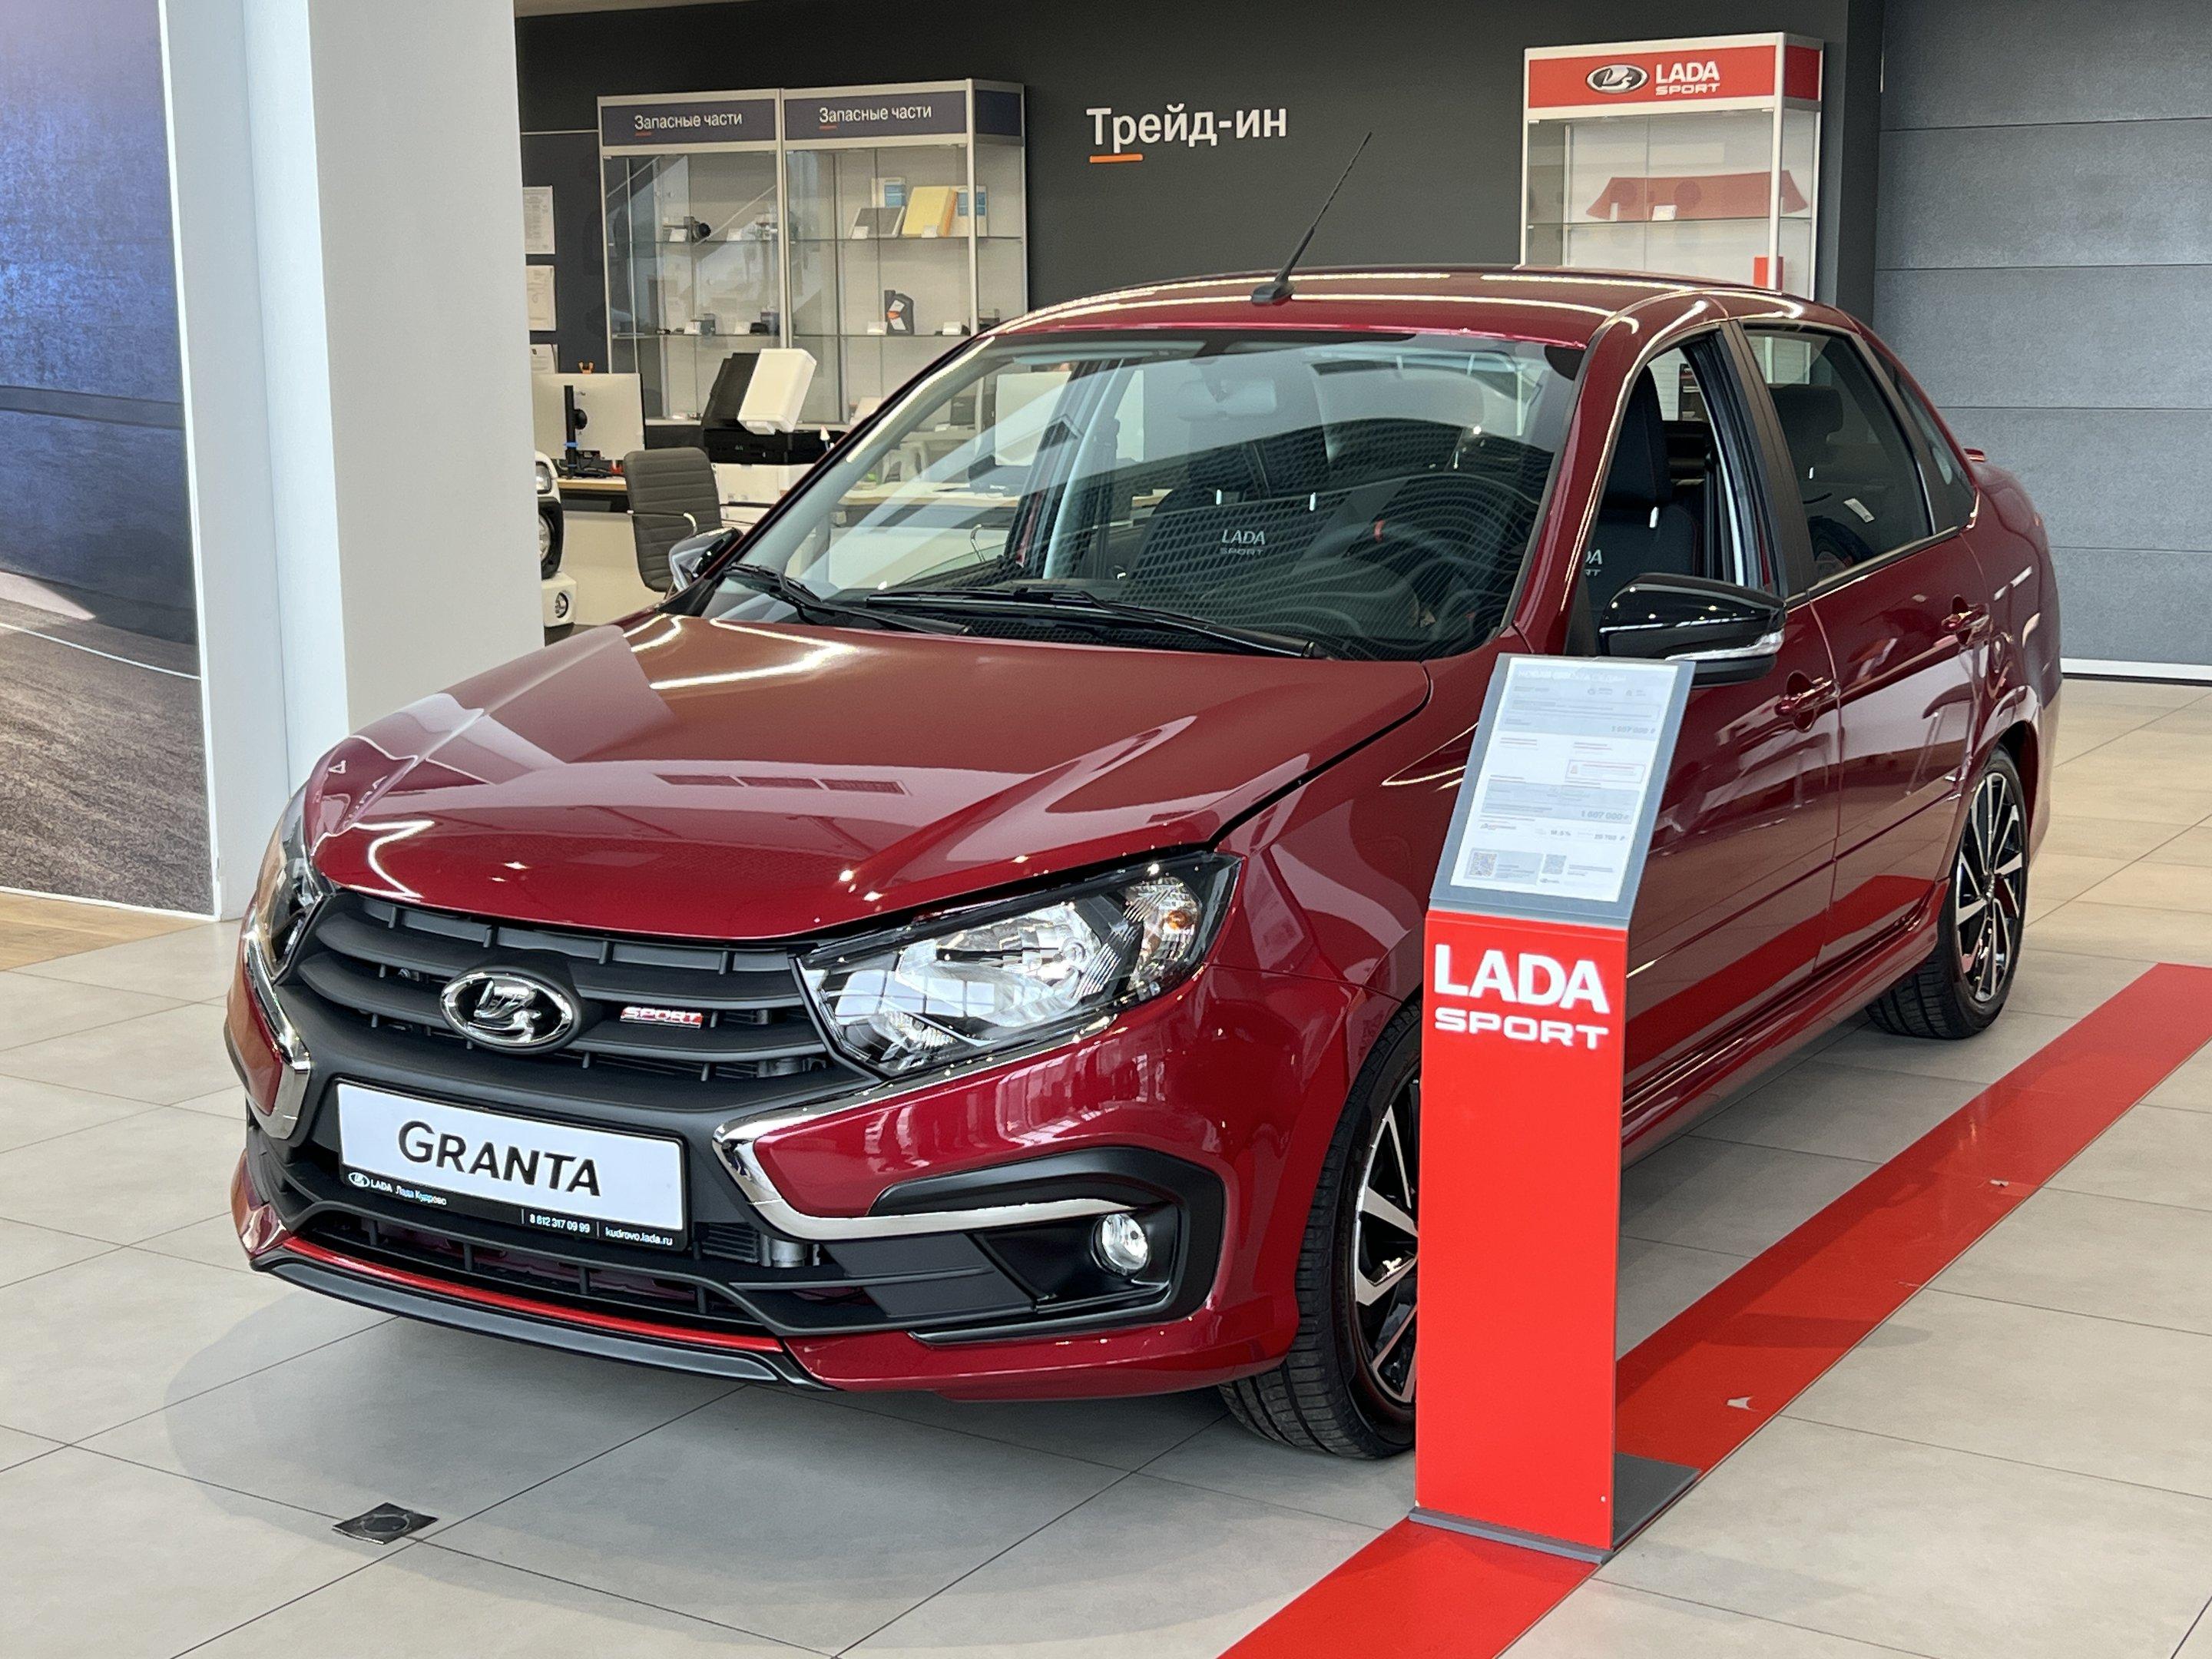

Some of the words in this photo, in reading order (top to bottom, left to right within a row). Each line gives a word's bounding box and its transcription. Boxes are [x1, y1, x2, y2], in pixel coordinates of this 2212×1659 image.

[1656, 61, 1720, 84] LADA
[1655, 83, 1720, 96] SPORT
[634, 114, 700, 130] Запасные
[704, 113, 742, 126] части
[819, 107, 889, 123] Запасные
[891, 105, 932, 119] части
[1086, 103, 1286, 154] Трейд-ин
[1221, 529, 1266, 545] LADA
[1434, 943, 1611, 1015] LADA
[1434, 1006, 1609, 1050] SPORT
[398, 1121, 601, 1197] GRANTA
[370, 1179, 393, 1193] LADA
[551, 1218, 566, 1229] 317
